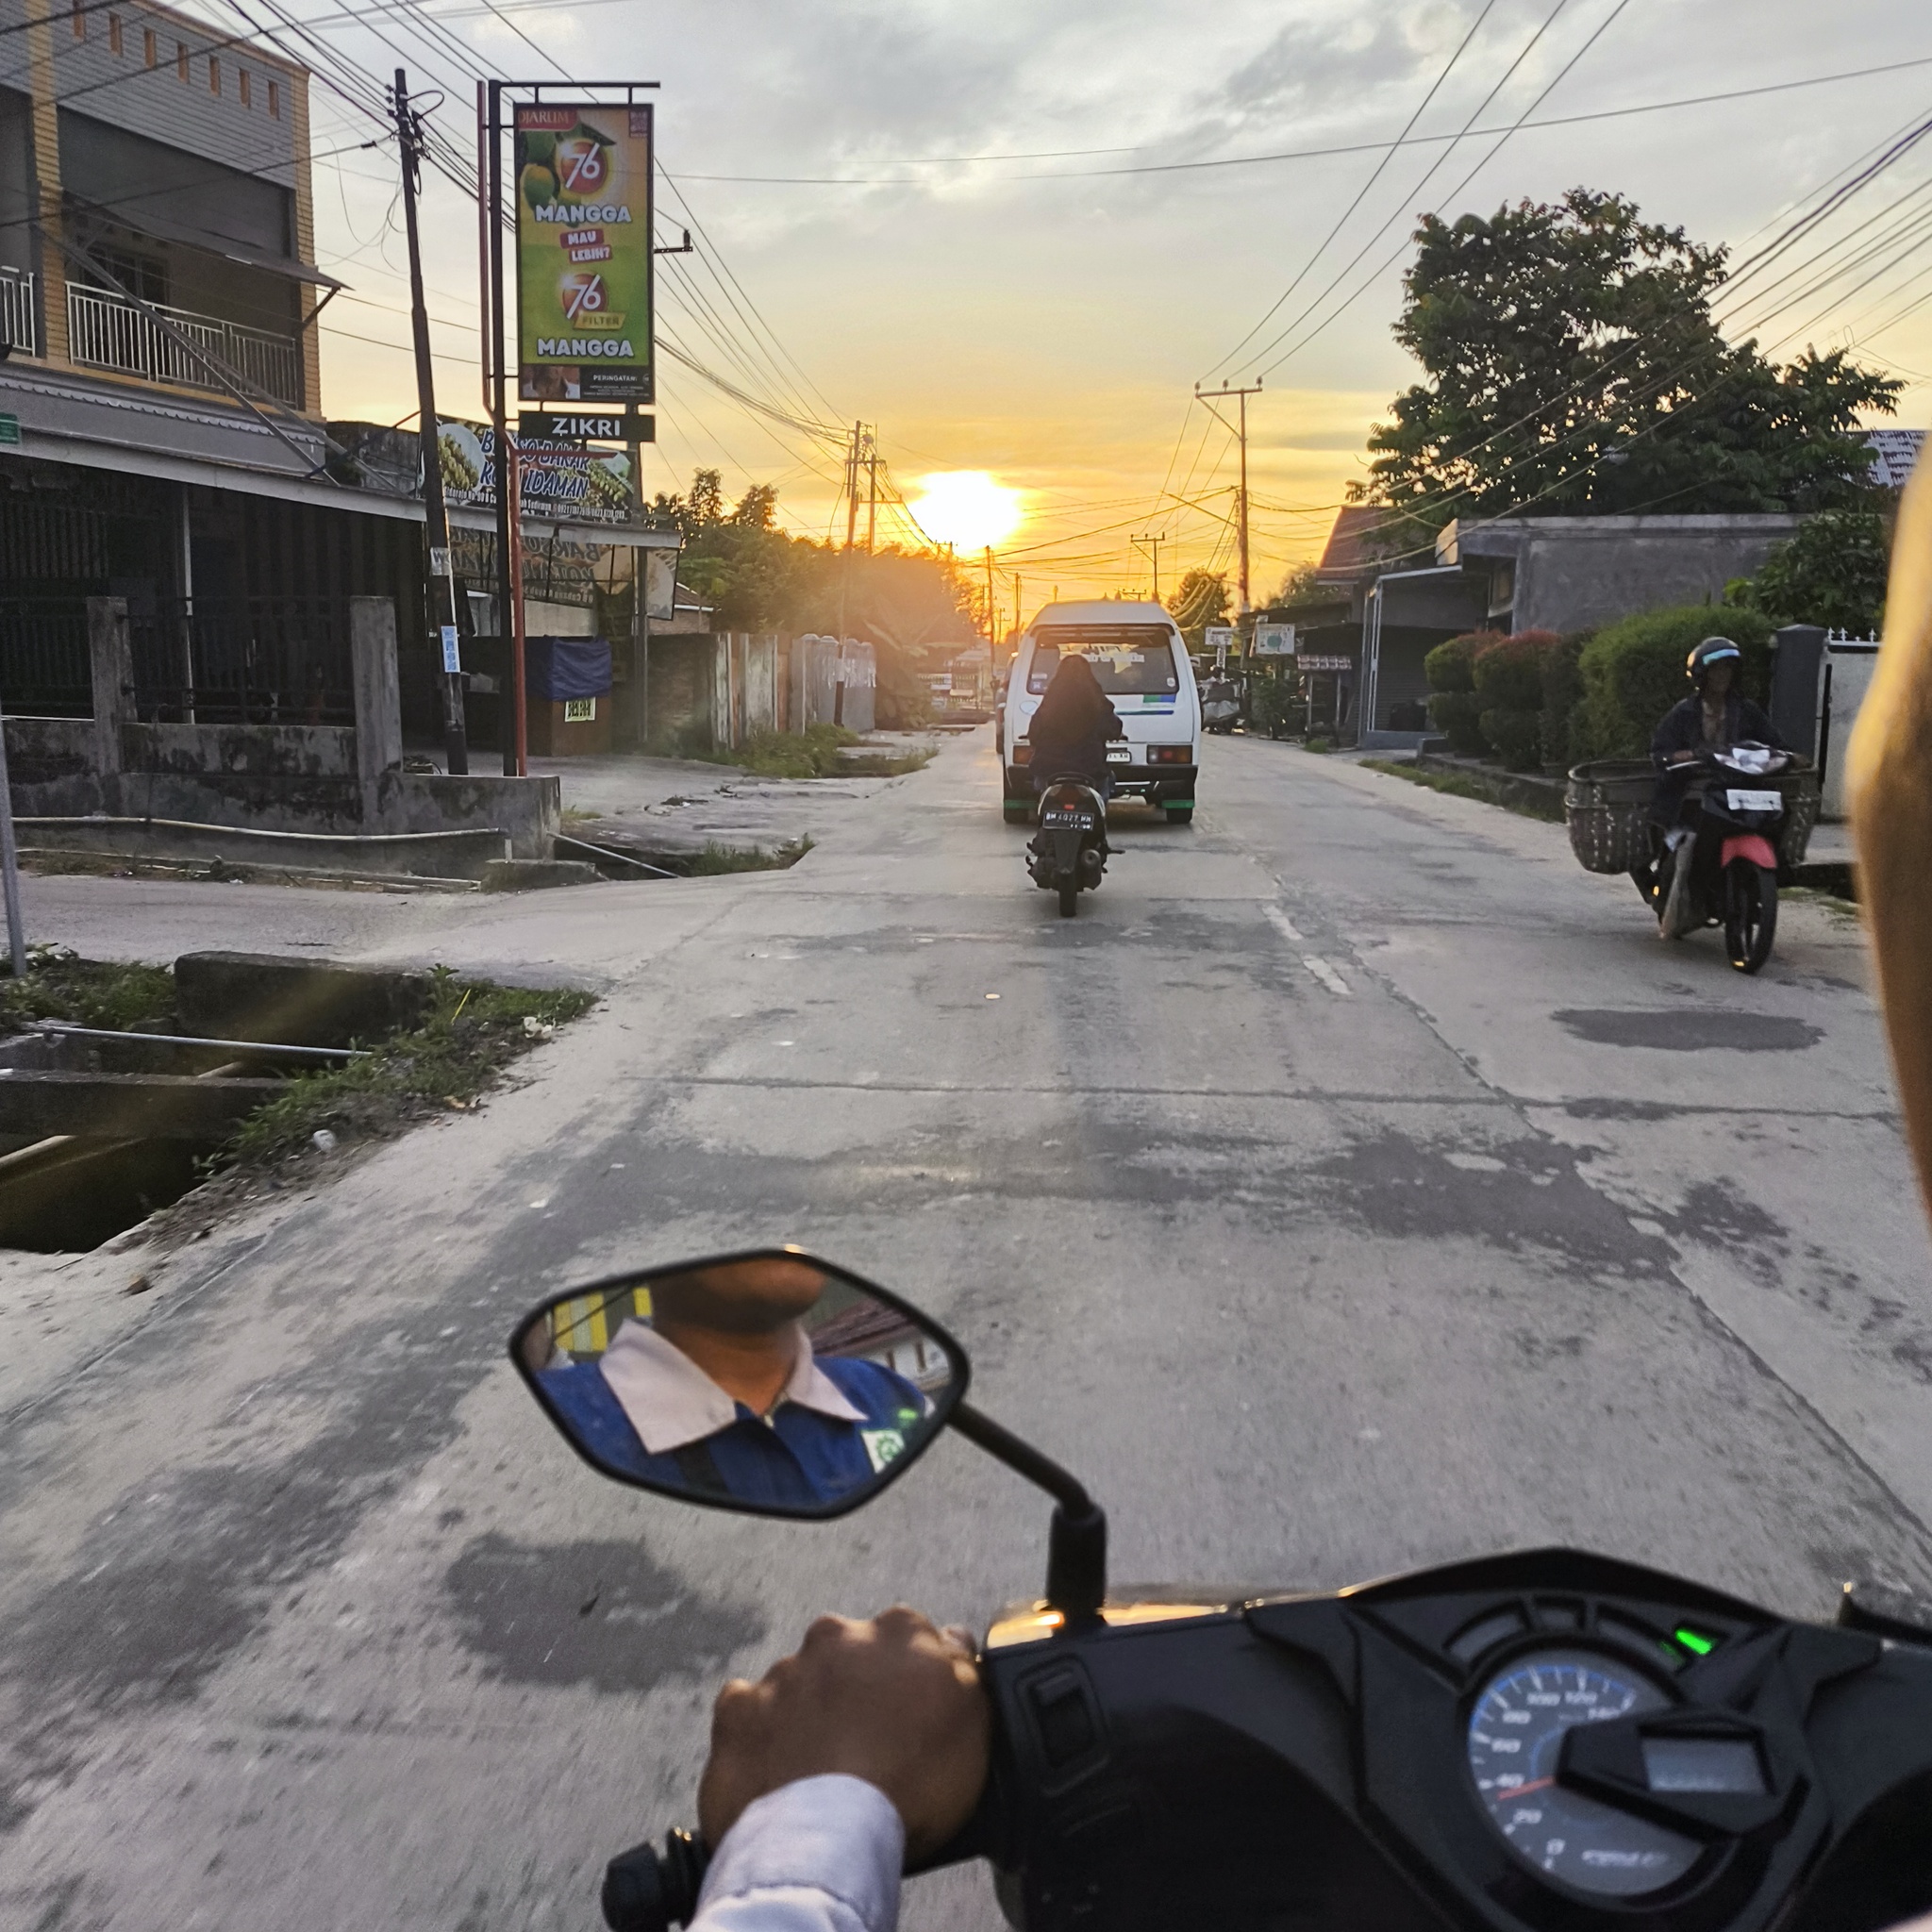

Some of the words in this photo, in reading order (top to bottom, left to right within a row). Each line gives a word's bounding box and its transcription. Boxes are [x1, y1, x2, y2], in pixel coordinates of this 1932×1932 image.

[565, 142, 601, 189] 76
[535, 204, 632, 223] MANGGA
[568, 230, 597, 245] MAU
[566, 274, 602, 320] 76
[581, 315, 620, 325] FILTER
[537, 338, 634, 358] MANGGA
[552, 417, 621, 436] ZIKRI
[524, 468, 590, 499] IDAMAN
